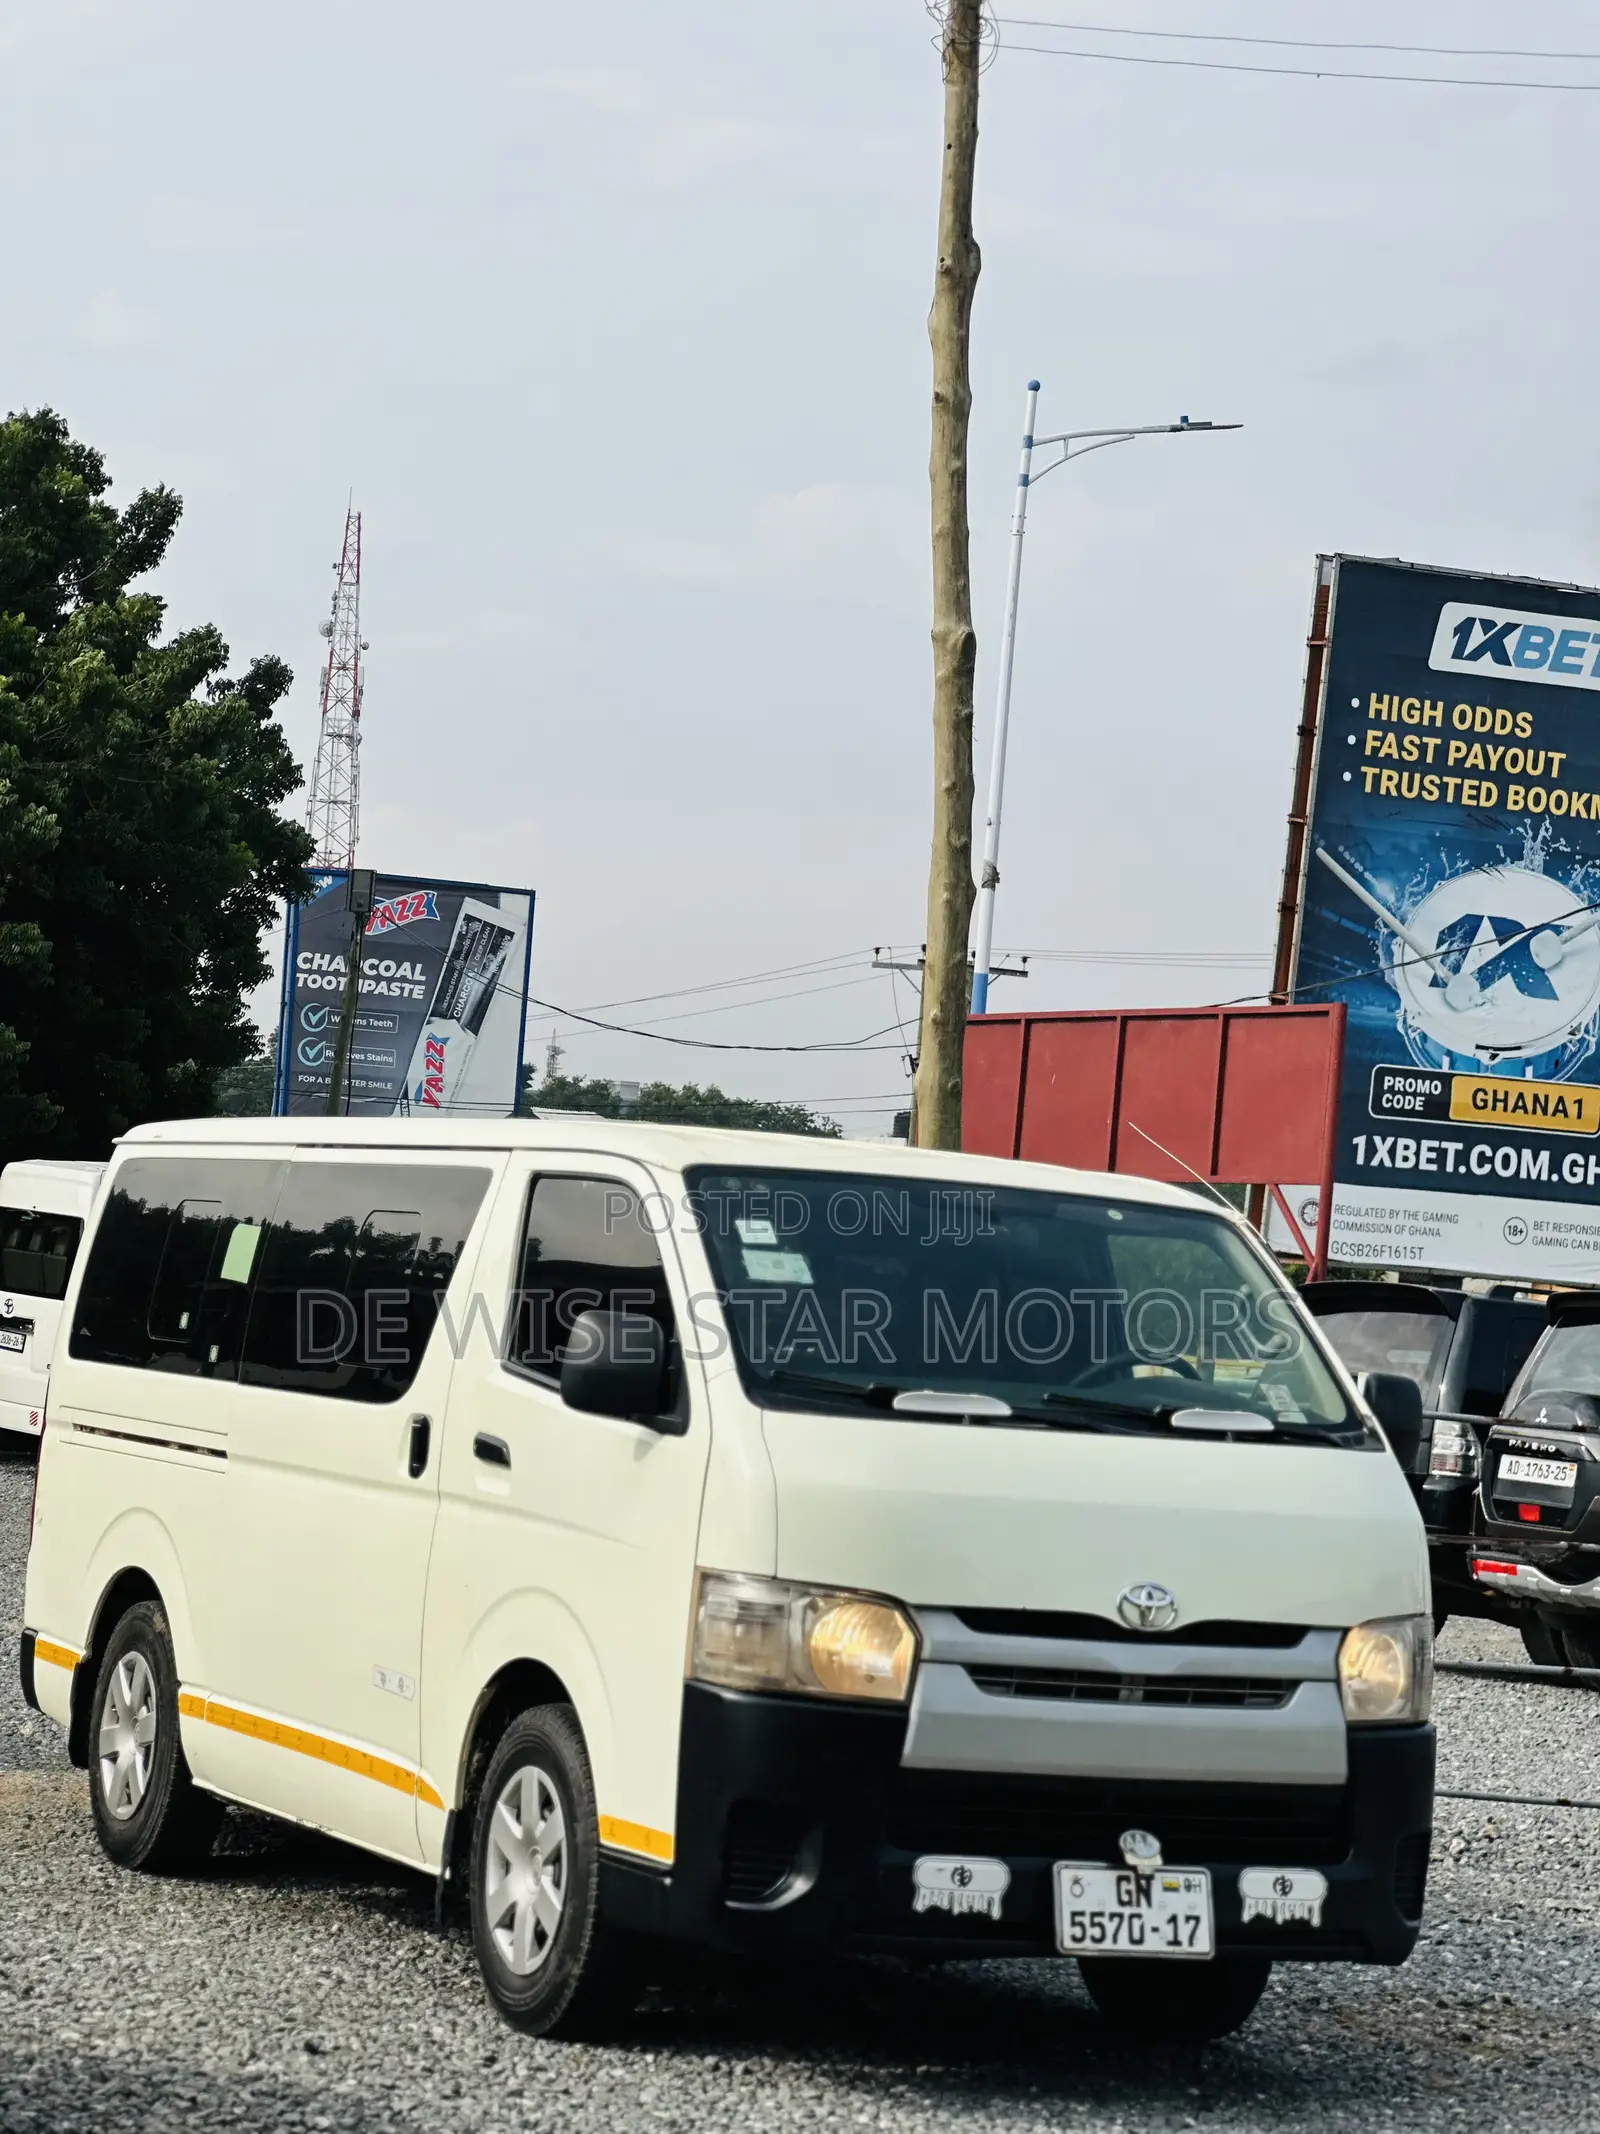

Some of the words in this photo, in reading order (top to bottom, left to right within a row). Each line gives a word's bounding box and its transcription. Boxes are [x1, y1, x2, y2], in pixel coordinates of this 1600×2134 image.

[1368, 692, 1444, 728] HIGH
[1452, 703, 1534, 739] ODDS
[1364, 730, 1442, 764] FAST
[1447, 740, 1567, 778] PAYOUT
[1360, 766, 1499, 808] TRUSTED
[296, 951, 427, 982] CHACOAL
[330, 1014, 367, 1026] Wens
[368, 1018, 393, 1028] Teeth
[325, 1049, 365, 1060] Roves
[366, 1053, 393, 1063] Stains
[298, 1075, 316, 1083] FOR
[316, 1076, 324, 1084] A
[325, 1077, 367, 1088] BHTER
[367, 1080, 393, 1090] SMILE
[422, 1039, 445, 1110] YAZZ
[1383, 1075, 1442, 1095] PROMO
[1381, 1093, 1425, 1111] CODE
[1471, 1087, 1584, 1120] GHANA1
[1352, 1134, 1600, 1186] 1XBET.COM.GH
[1334, 1204, 1386, 1219] REGULATED
[1389, 1208, 1400, 1220] BY
[1403, 1210, 1420, 1221] THE
[1422, 1211, 1459, 1224] GAMING
[1332, 1219, 1392, 1235] COMMISSION
[1394, 1224, 1406, 1235] OF
[1408, 1225, 1441, 1238] GHANA
[1507, 1224, 1524, 1237] 18+
[1533, 1220, 1550, 1232] BET
[1331, 1240, 1425, 1261] GCSB26F1615T
[1531, 1235, 1569, 1249] GAMING
[1571, 1238, 1591, 1251] CAN
[1593, 1241, 1600, 1252] B
[1507, 1460, 1520, 1475] AD
[1525, 1462, 1568, 1481] 1763-25
[1116, 1874, 1155, 1909] GN
[1069, 1910, 1201, 1947] 5570-17
